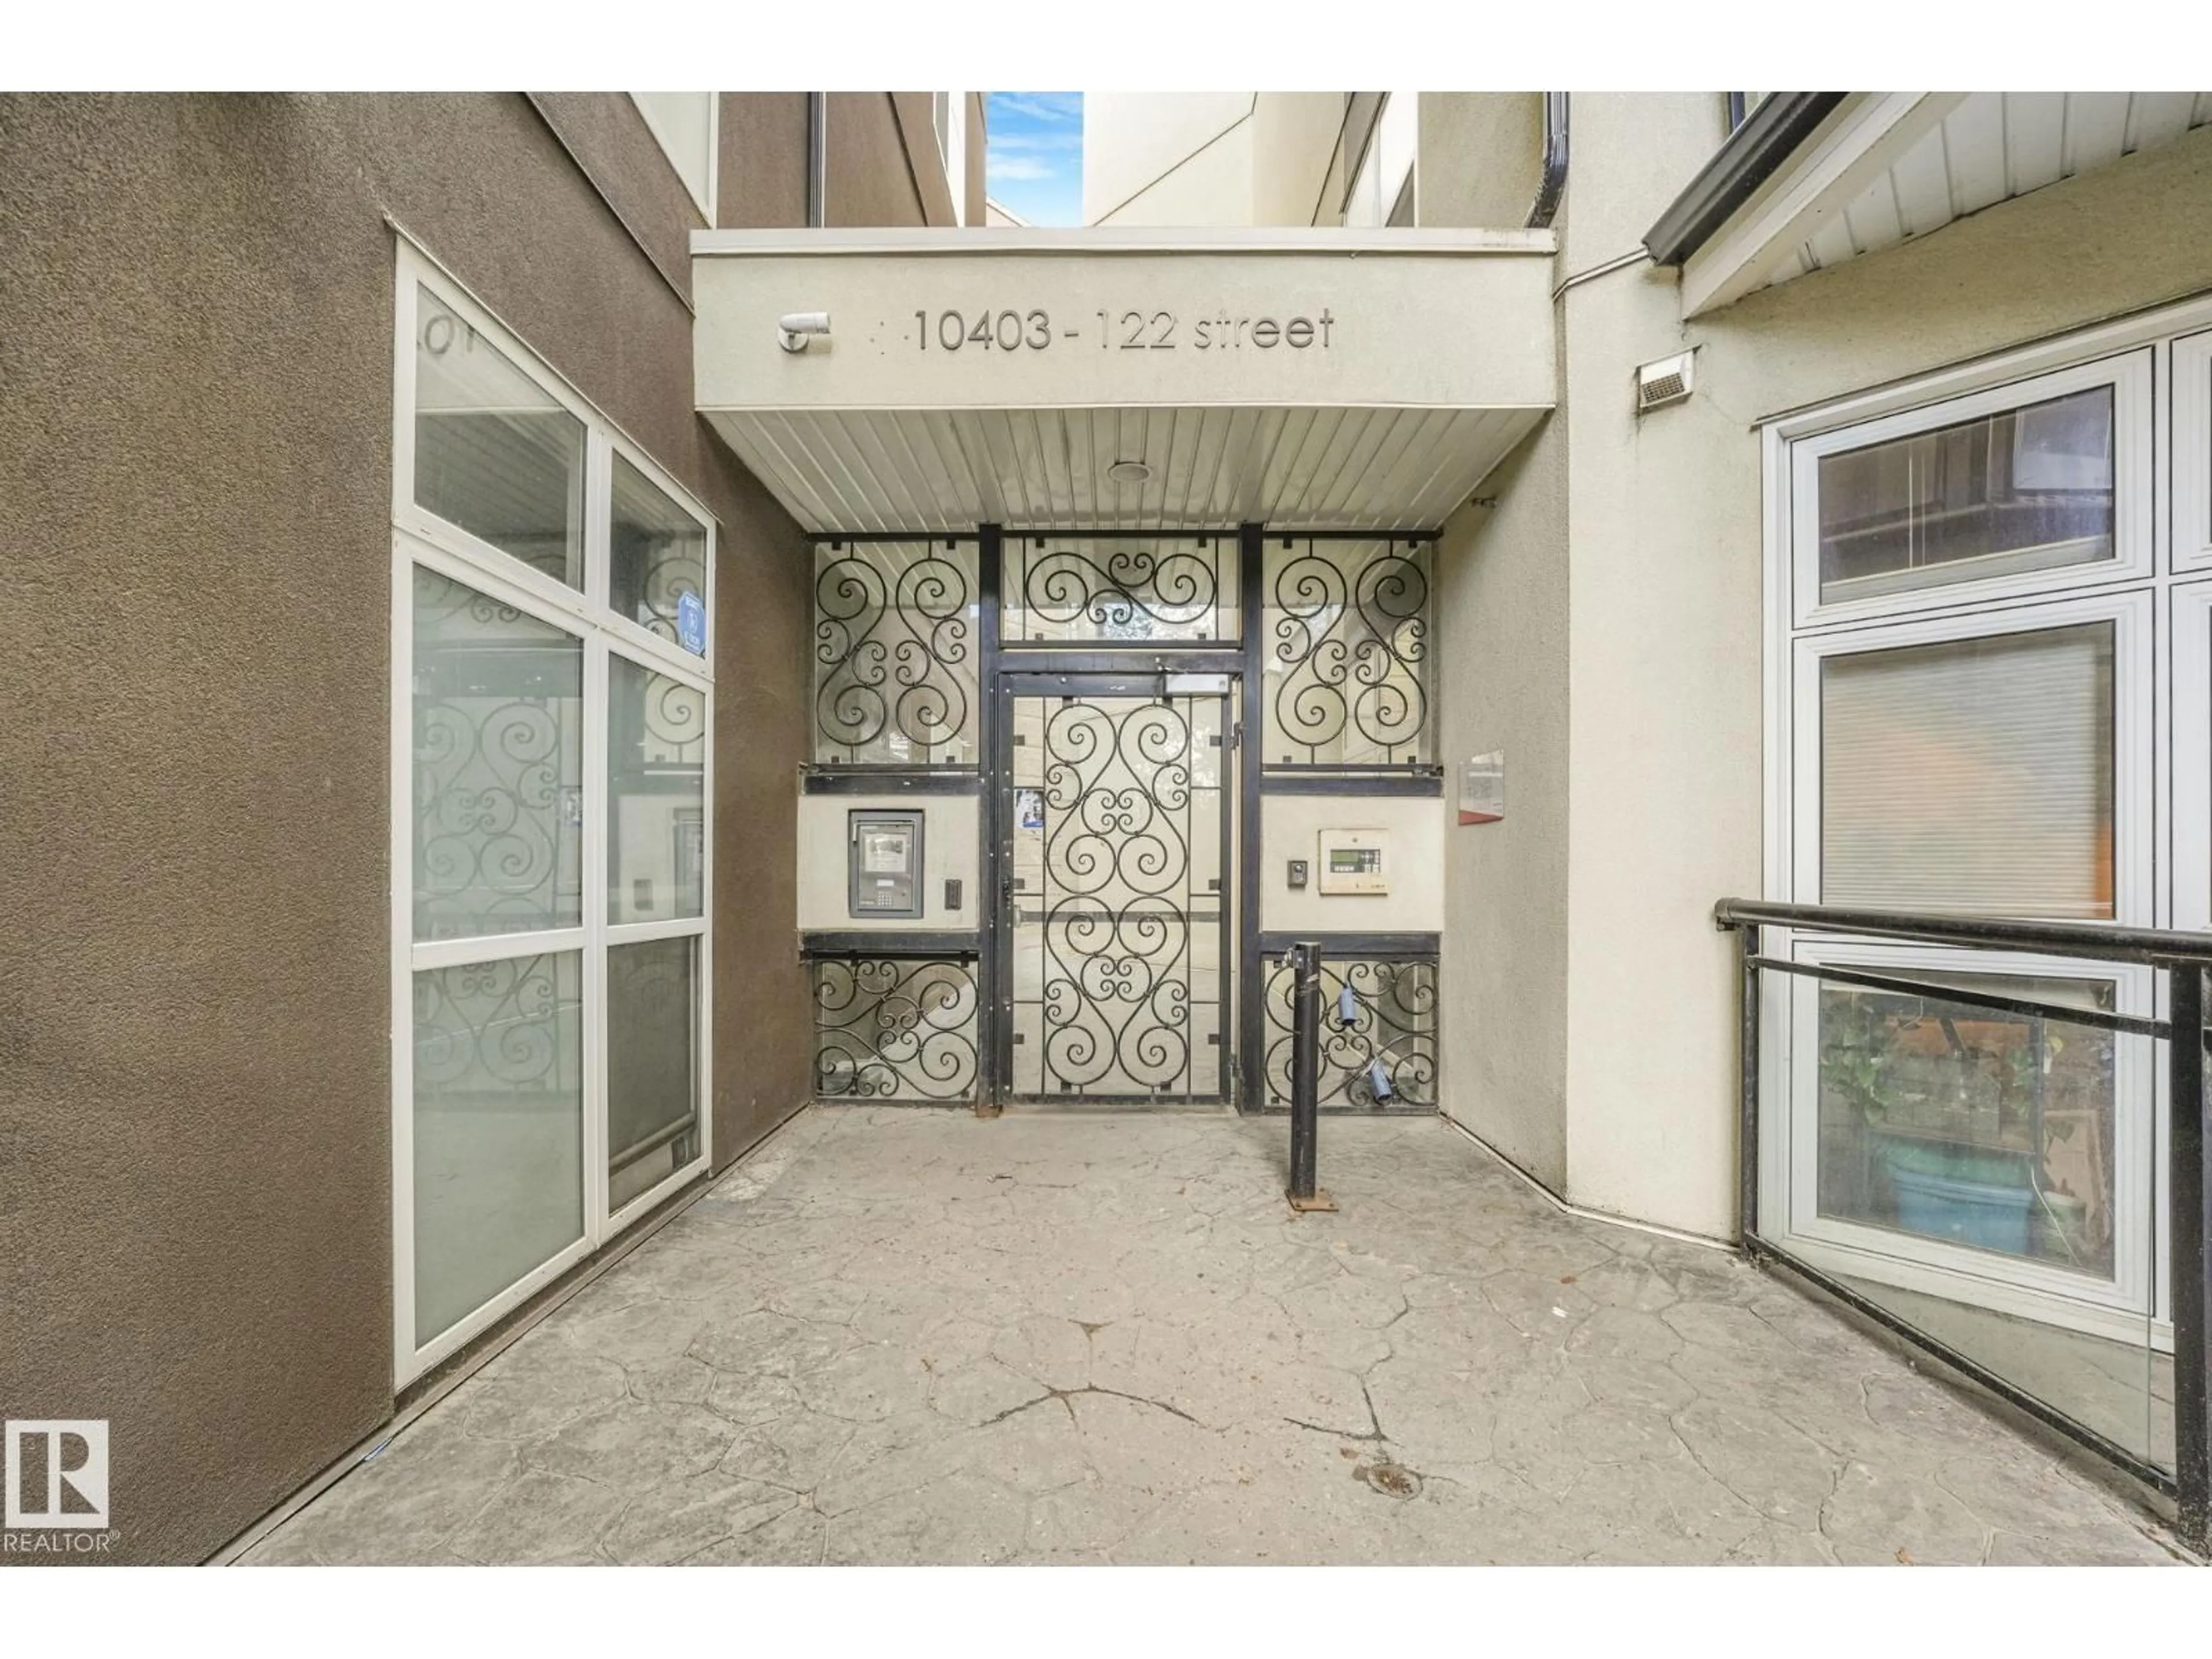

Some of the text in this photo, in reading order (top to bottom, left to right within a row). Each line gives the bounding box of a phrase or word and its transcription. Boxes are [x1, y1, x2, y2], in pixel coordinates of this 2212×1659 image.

[915, 309, 1052, 350] 10403
[1097, 309, 1176, 349] 122
[1194, 308, 1335, 349] street
